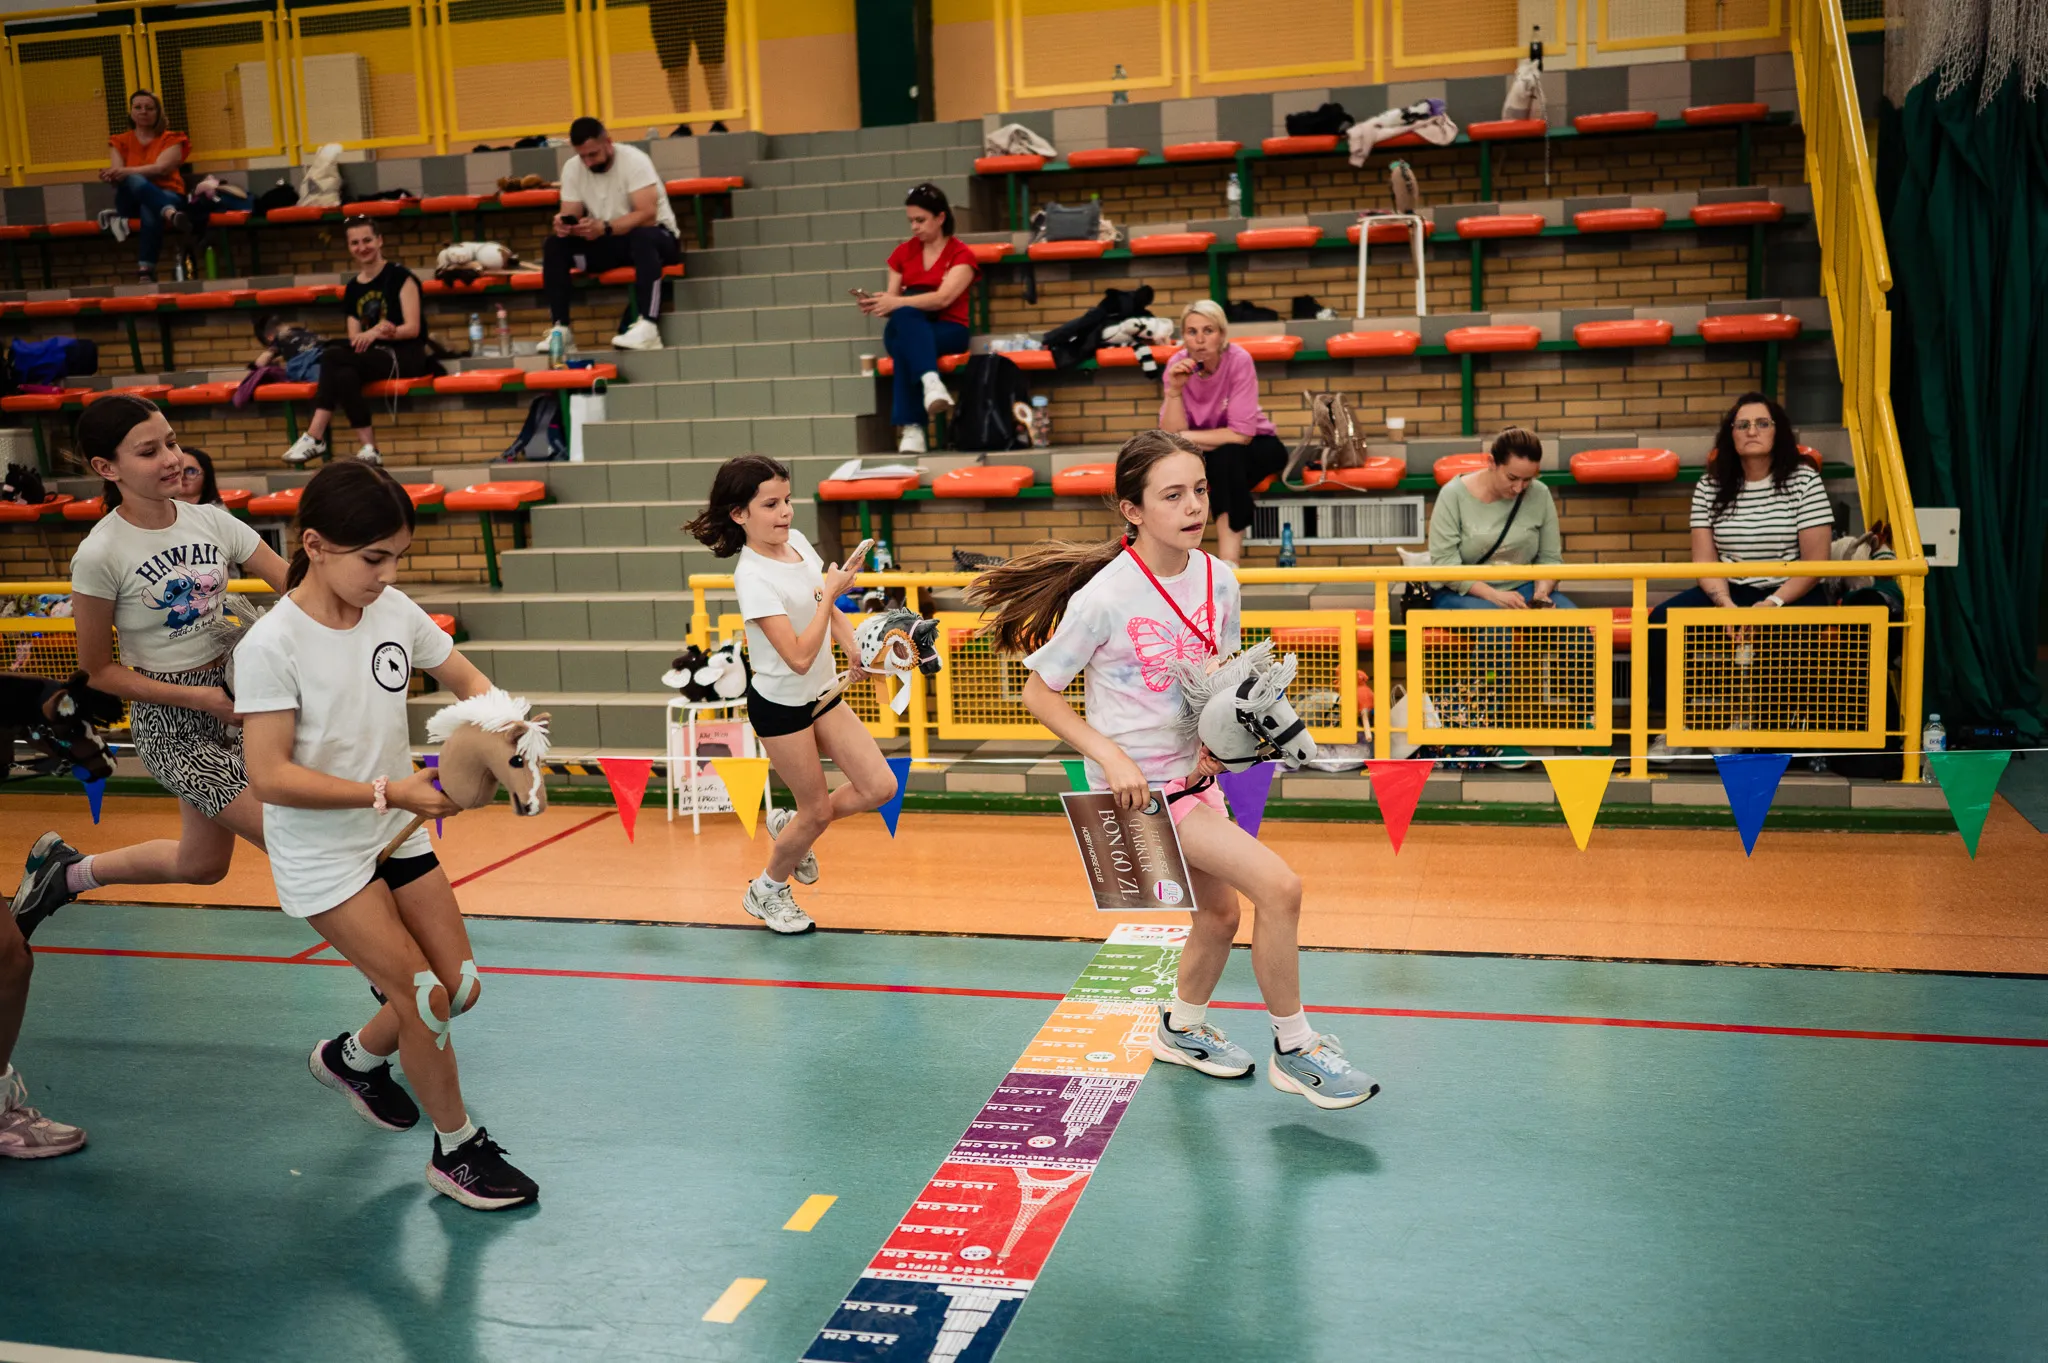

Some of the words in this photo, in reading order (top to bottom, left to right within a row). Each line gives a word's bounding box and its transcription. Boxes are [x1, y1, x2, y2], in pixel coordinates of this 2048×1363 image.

[135, 543, 220, 585] HAWAII
[1098, 809, 1124, 846] BON
[1110, 850, 1132, 873] 60
[959, 1141, 983, 1149] CM
[987, 1143, 1019, 1151] 140
[933, 1181, 956, 1189] CM
[962, 1182, 994, 1191] 160
[916, 1202, 941, 1211] CM
[946, 1204, 979, 1213] 170
[900, 1226, 925, 1234] CM
[882, 1250, 908, 1258] CM
[914, 1252, 949, 1261] 190
[844, 1303, 871, 1311] CM
[877, 1306, 917, 1315] 210
[822, 1332, 852, 1341] CM
[856, 1335, 898, 1345] 220
